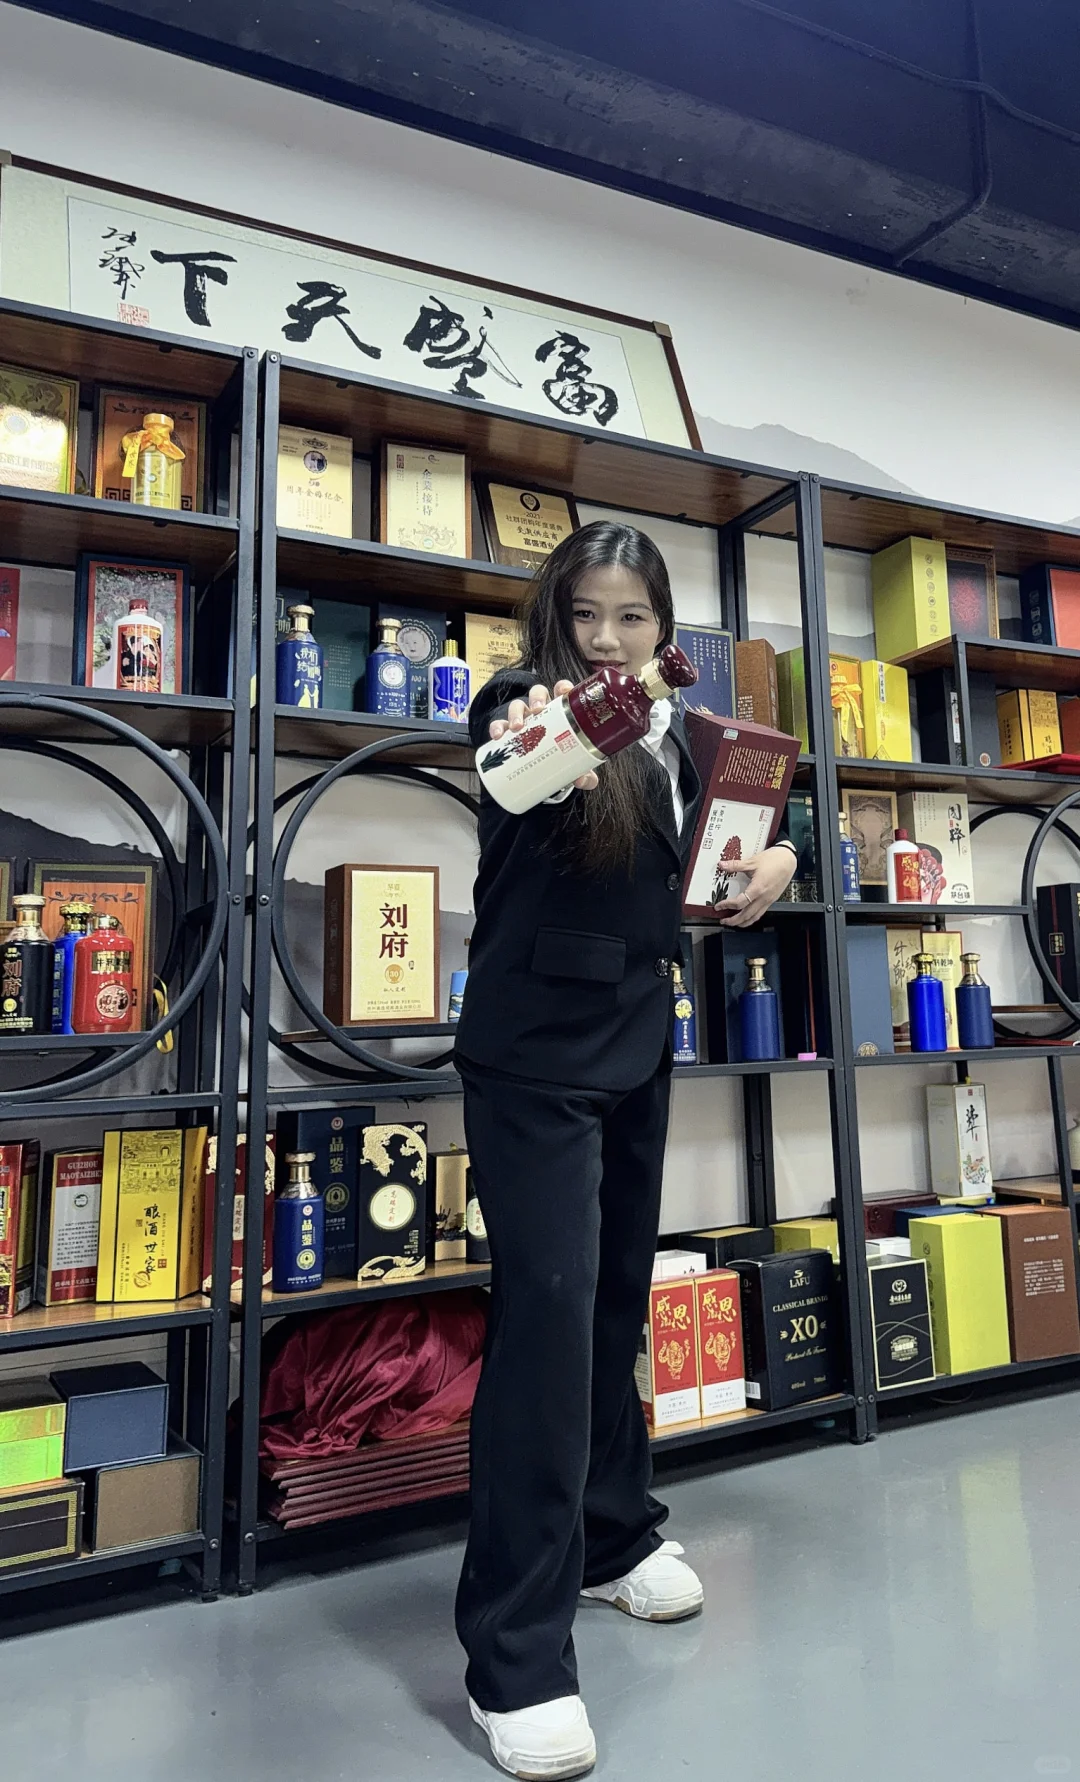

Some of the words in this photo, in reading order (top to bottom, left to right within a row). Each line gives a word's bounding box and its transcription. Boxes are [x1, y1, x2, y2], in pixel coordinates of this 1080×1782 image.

[379, 902, 409, 959] 刘府
[1, 960, 22, 997] 刘府
[60, 1171, 102, 1181] MAOTAIZHE
[67, 1160, 99, 1170] GUIZHOU
[143, 1203, 160, 1274] 酿酒世家
[789, 1276, 811, 1288] LAFU
[655, 1295, 691, 1330] 感恩
[702, 1287, 737, 1323] 感恩
[772, 1299, 807, 1313] CLASSICAL
[789, 1314, 819, 1344] XO
